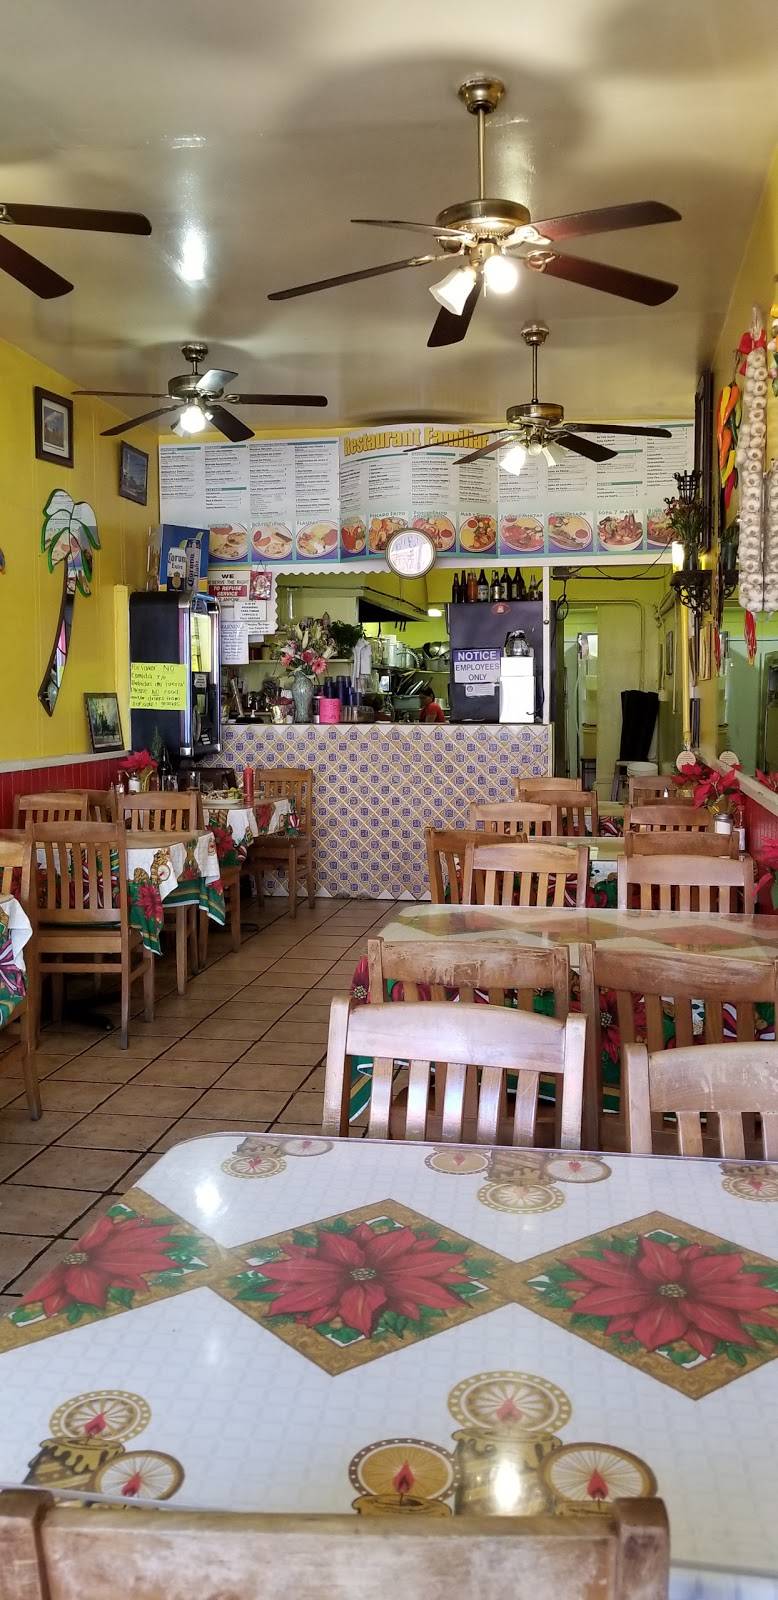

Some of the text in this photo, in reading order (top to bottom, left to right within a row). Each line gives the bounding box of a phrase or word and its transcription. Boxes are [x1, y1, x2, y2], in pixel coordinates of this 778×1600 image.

[343, 428, 490, 456] Restaurant Familiar
[457, 651, 497, 661] NOTICE
[455, 663, 499, 671] EMPLOYEES
[468, 673, 487, 681] ONLY
